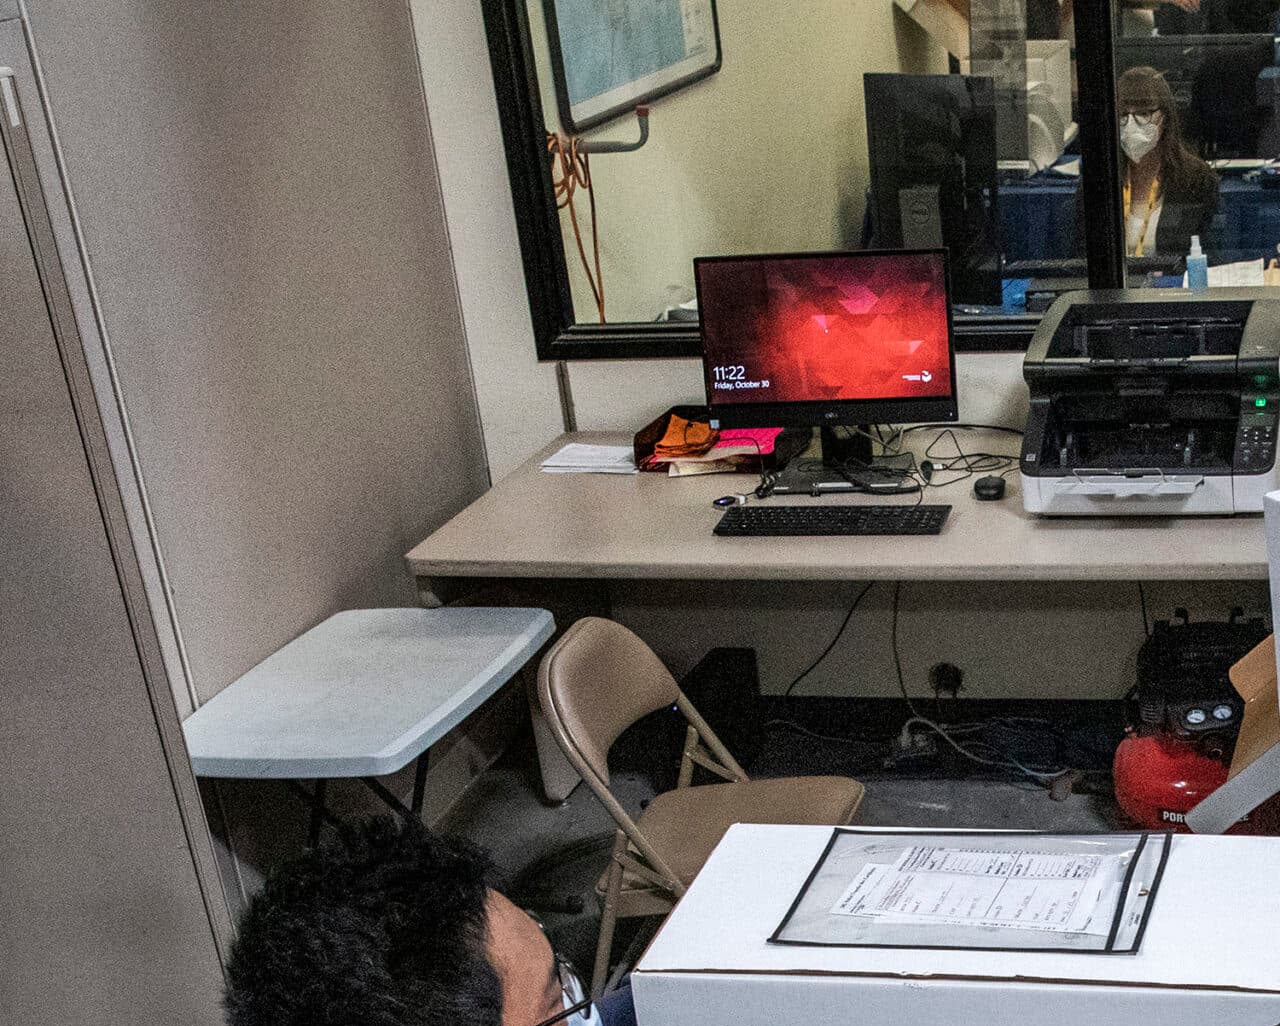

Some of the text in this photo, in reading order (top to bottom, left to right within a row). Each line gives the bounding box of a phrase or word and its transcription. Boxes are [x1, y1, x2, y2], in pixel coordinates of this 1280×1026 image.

[713, 365, 746, 380] 11:22
[714, 382, 735, 390] Friday,
[735, 381, 760, 389] October
